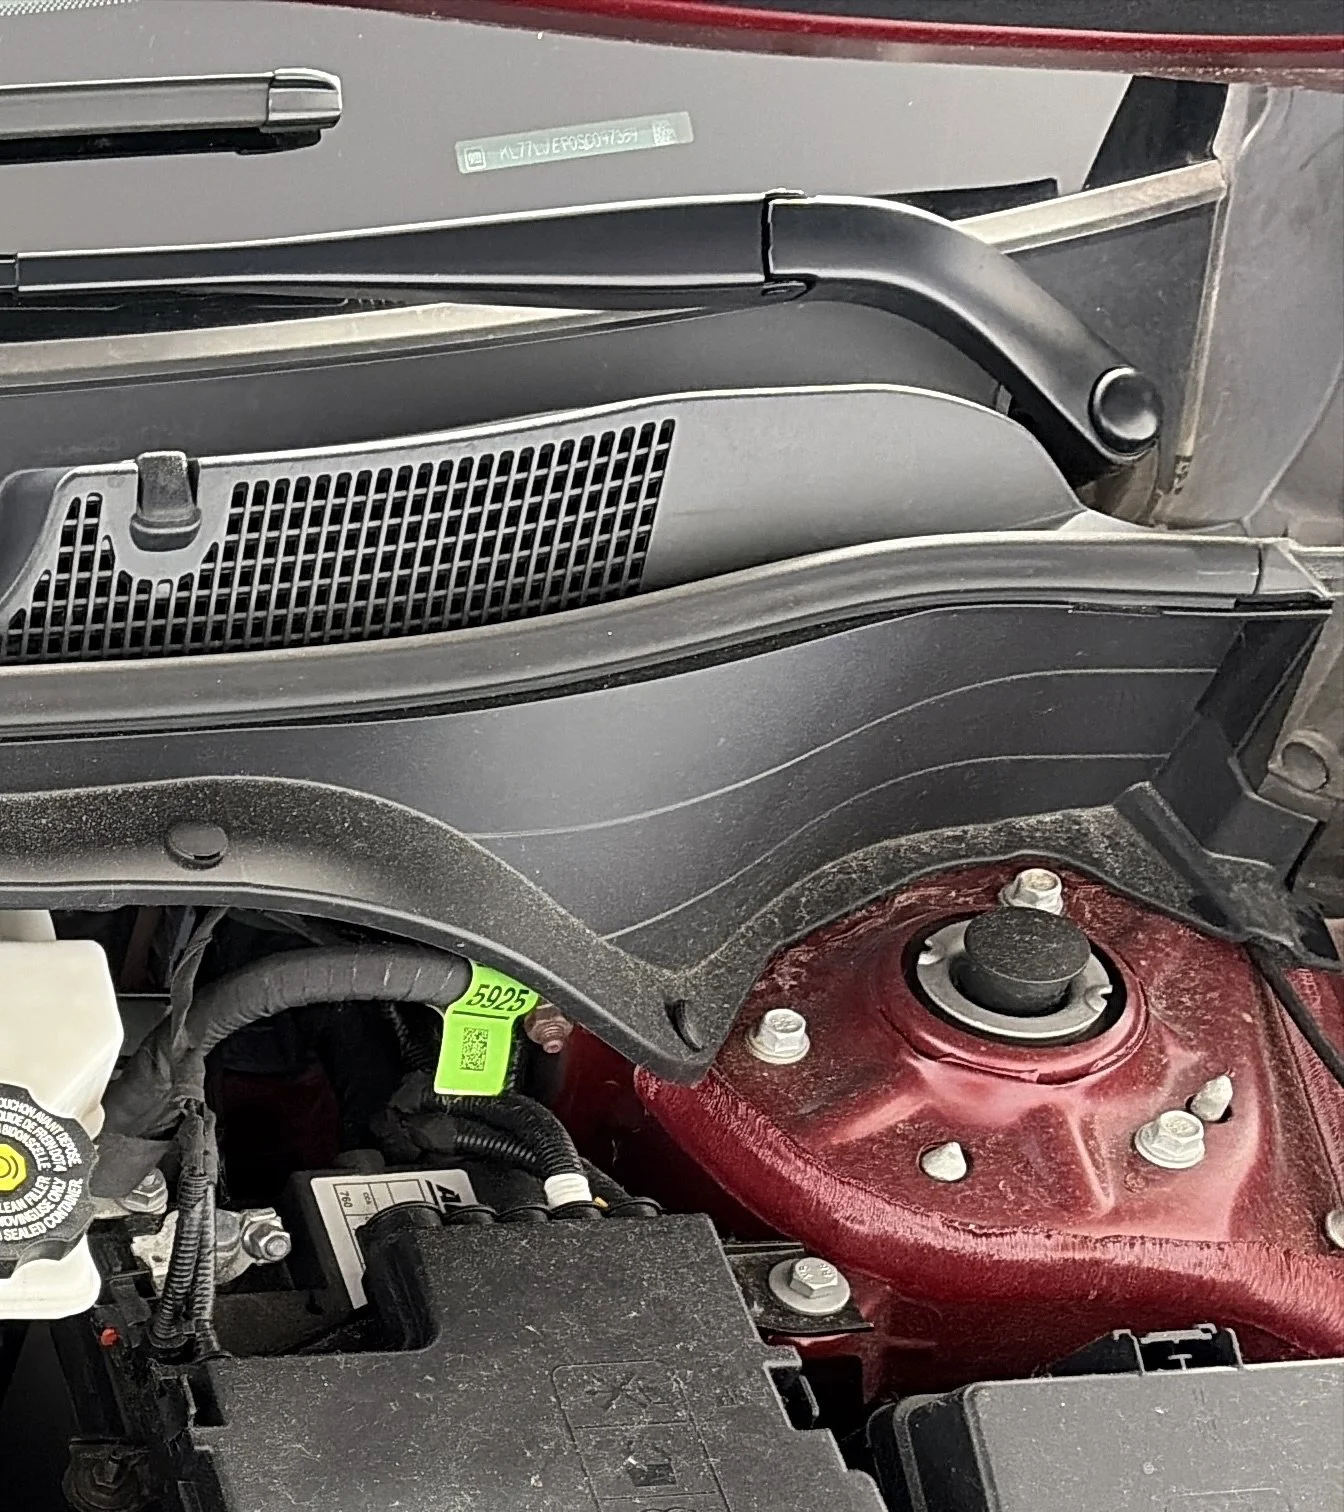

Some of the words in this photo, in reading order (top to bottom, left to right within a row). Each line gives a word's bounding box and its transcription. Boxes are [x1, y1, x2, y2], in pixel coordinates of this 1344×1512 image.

[466, 984, 530, 1012] 5925
[21, 1119, 37, 1132] DE
[24, 1176, 51, 1205] FILLER
[47, 1177, 68, 1202] ONLY
[339, 1190, 353, 1208] 760
[3, 1218, 47, 1241] SEALED
